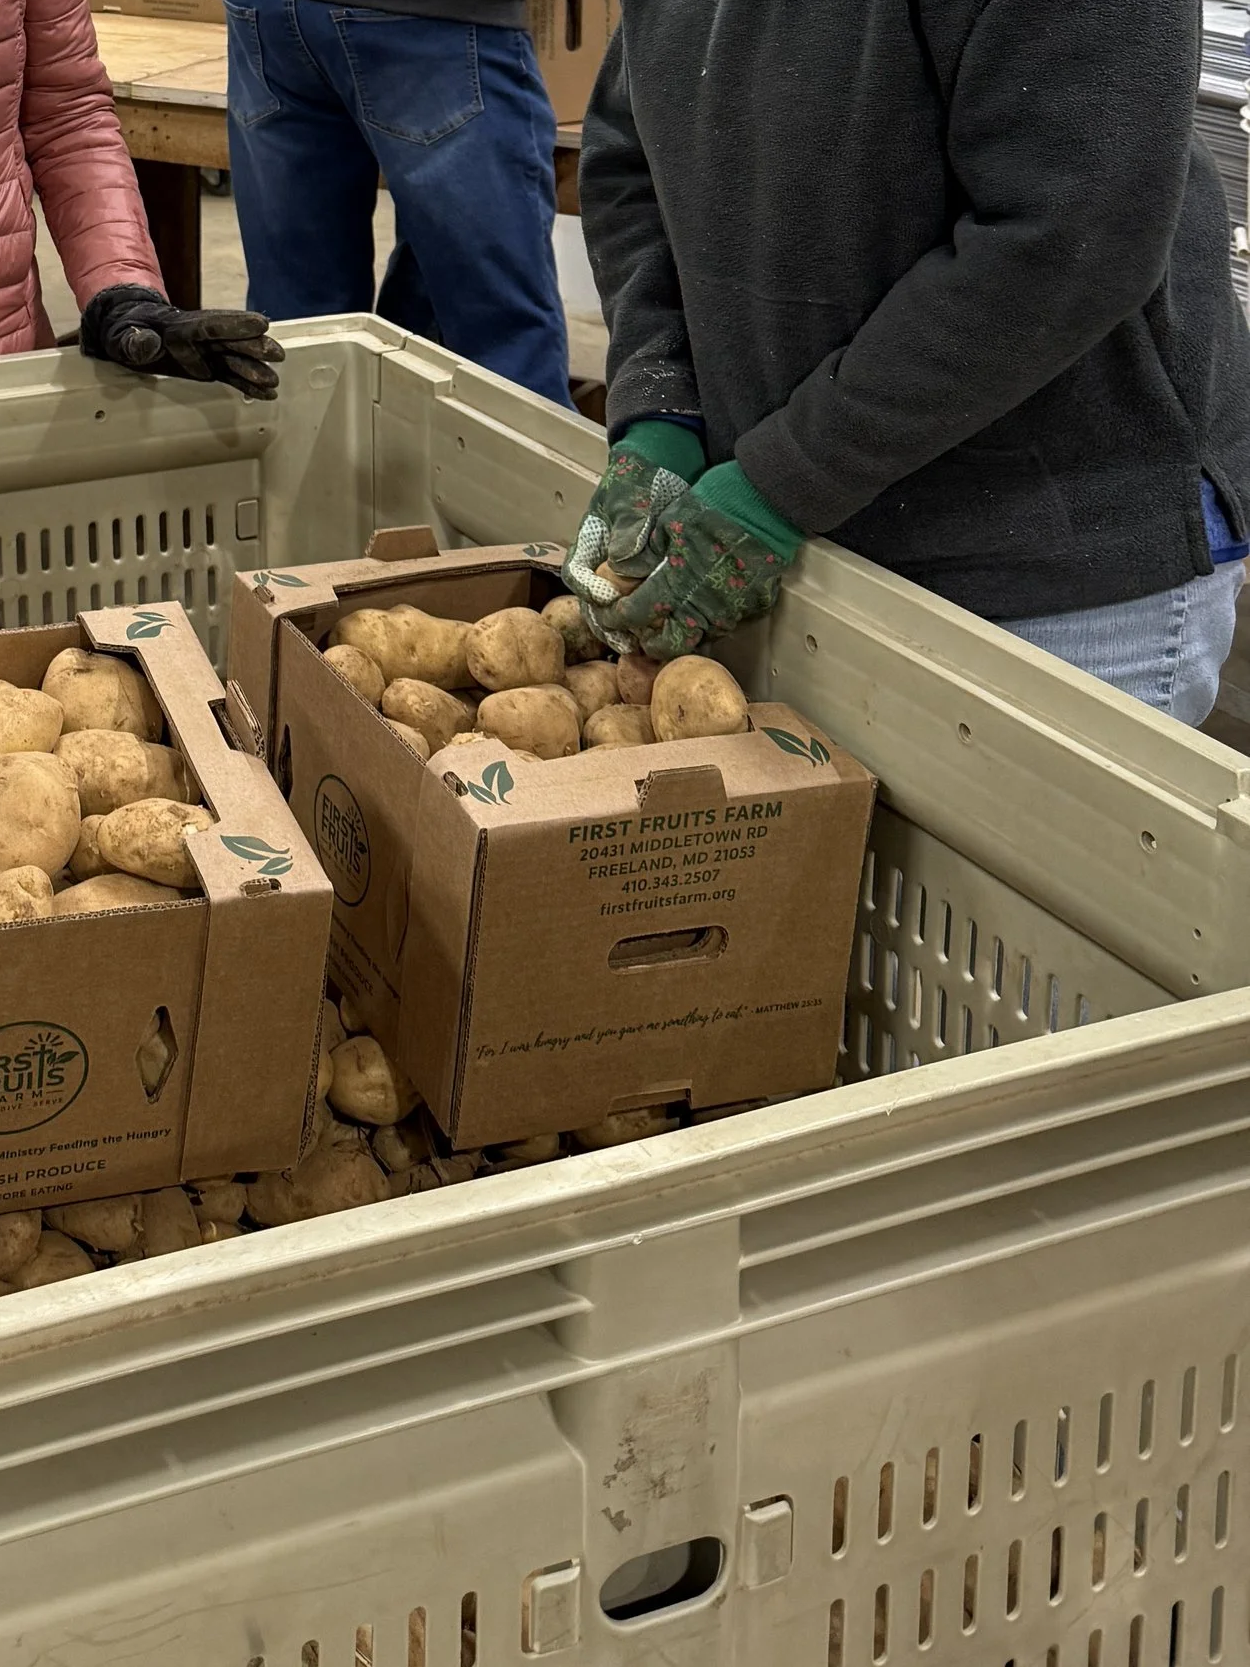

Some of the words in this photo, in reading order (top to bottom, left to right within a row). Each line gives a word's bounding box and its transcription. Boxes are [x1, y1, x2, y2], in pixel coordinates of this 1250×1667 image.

[321, 793, 363, 839] FIRST
[569, 819, 632, 844] FIRST
[639, 809, 716, 834] FRUITS
[724, 801, 783, 823] FARM
[321, 817, 361, 875] FRUITS
[579, 843, 625, 862] 20431
[630, 827, 742, 855] MIDDLETOWN
[746, 825, 768, 840] RD
[588, 856, 677, 880] FREELAND,
[682, 852, 708, 867] MD
[714, 845, 756, 862] 21053
[621, 869, 721, 894] 410.343.2507
[600, 888, 736, 916] firstfruitsfarm.org
[509, 1044, 530, 1053] was
[530, 1031, 570, 1051] hungry
[574, 1027, 596, 1042] and
[596, 1029, 616, 1045] you
[616, 1024, 643, 1040] gave
[661, 1007, 709, 1031] something
[711, 1007, 724, 1022] to
[755, 1002, 799, 1014] MATTHEW
[801, 998, 823, 1008] 25:35
[50, 1137, 98, 1153] Feeding
[102, 1134, 122, 1145] the
[126, 1128, 171, 1142] Hungry
[26, 1159, 107, 1181] PRODUCE
[31, 1182, 73, 1197] EATING
